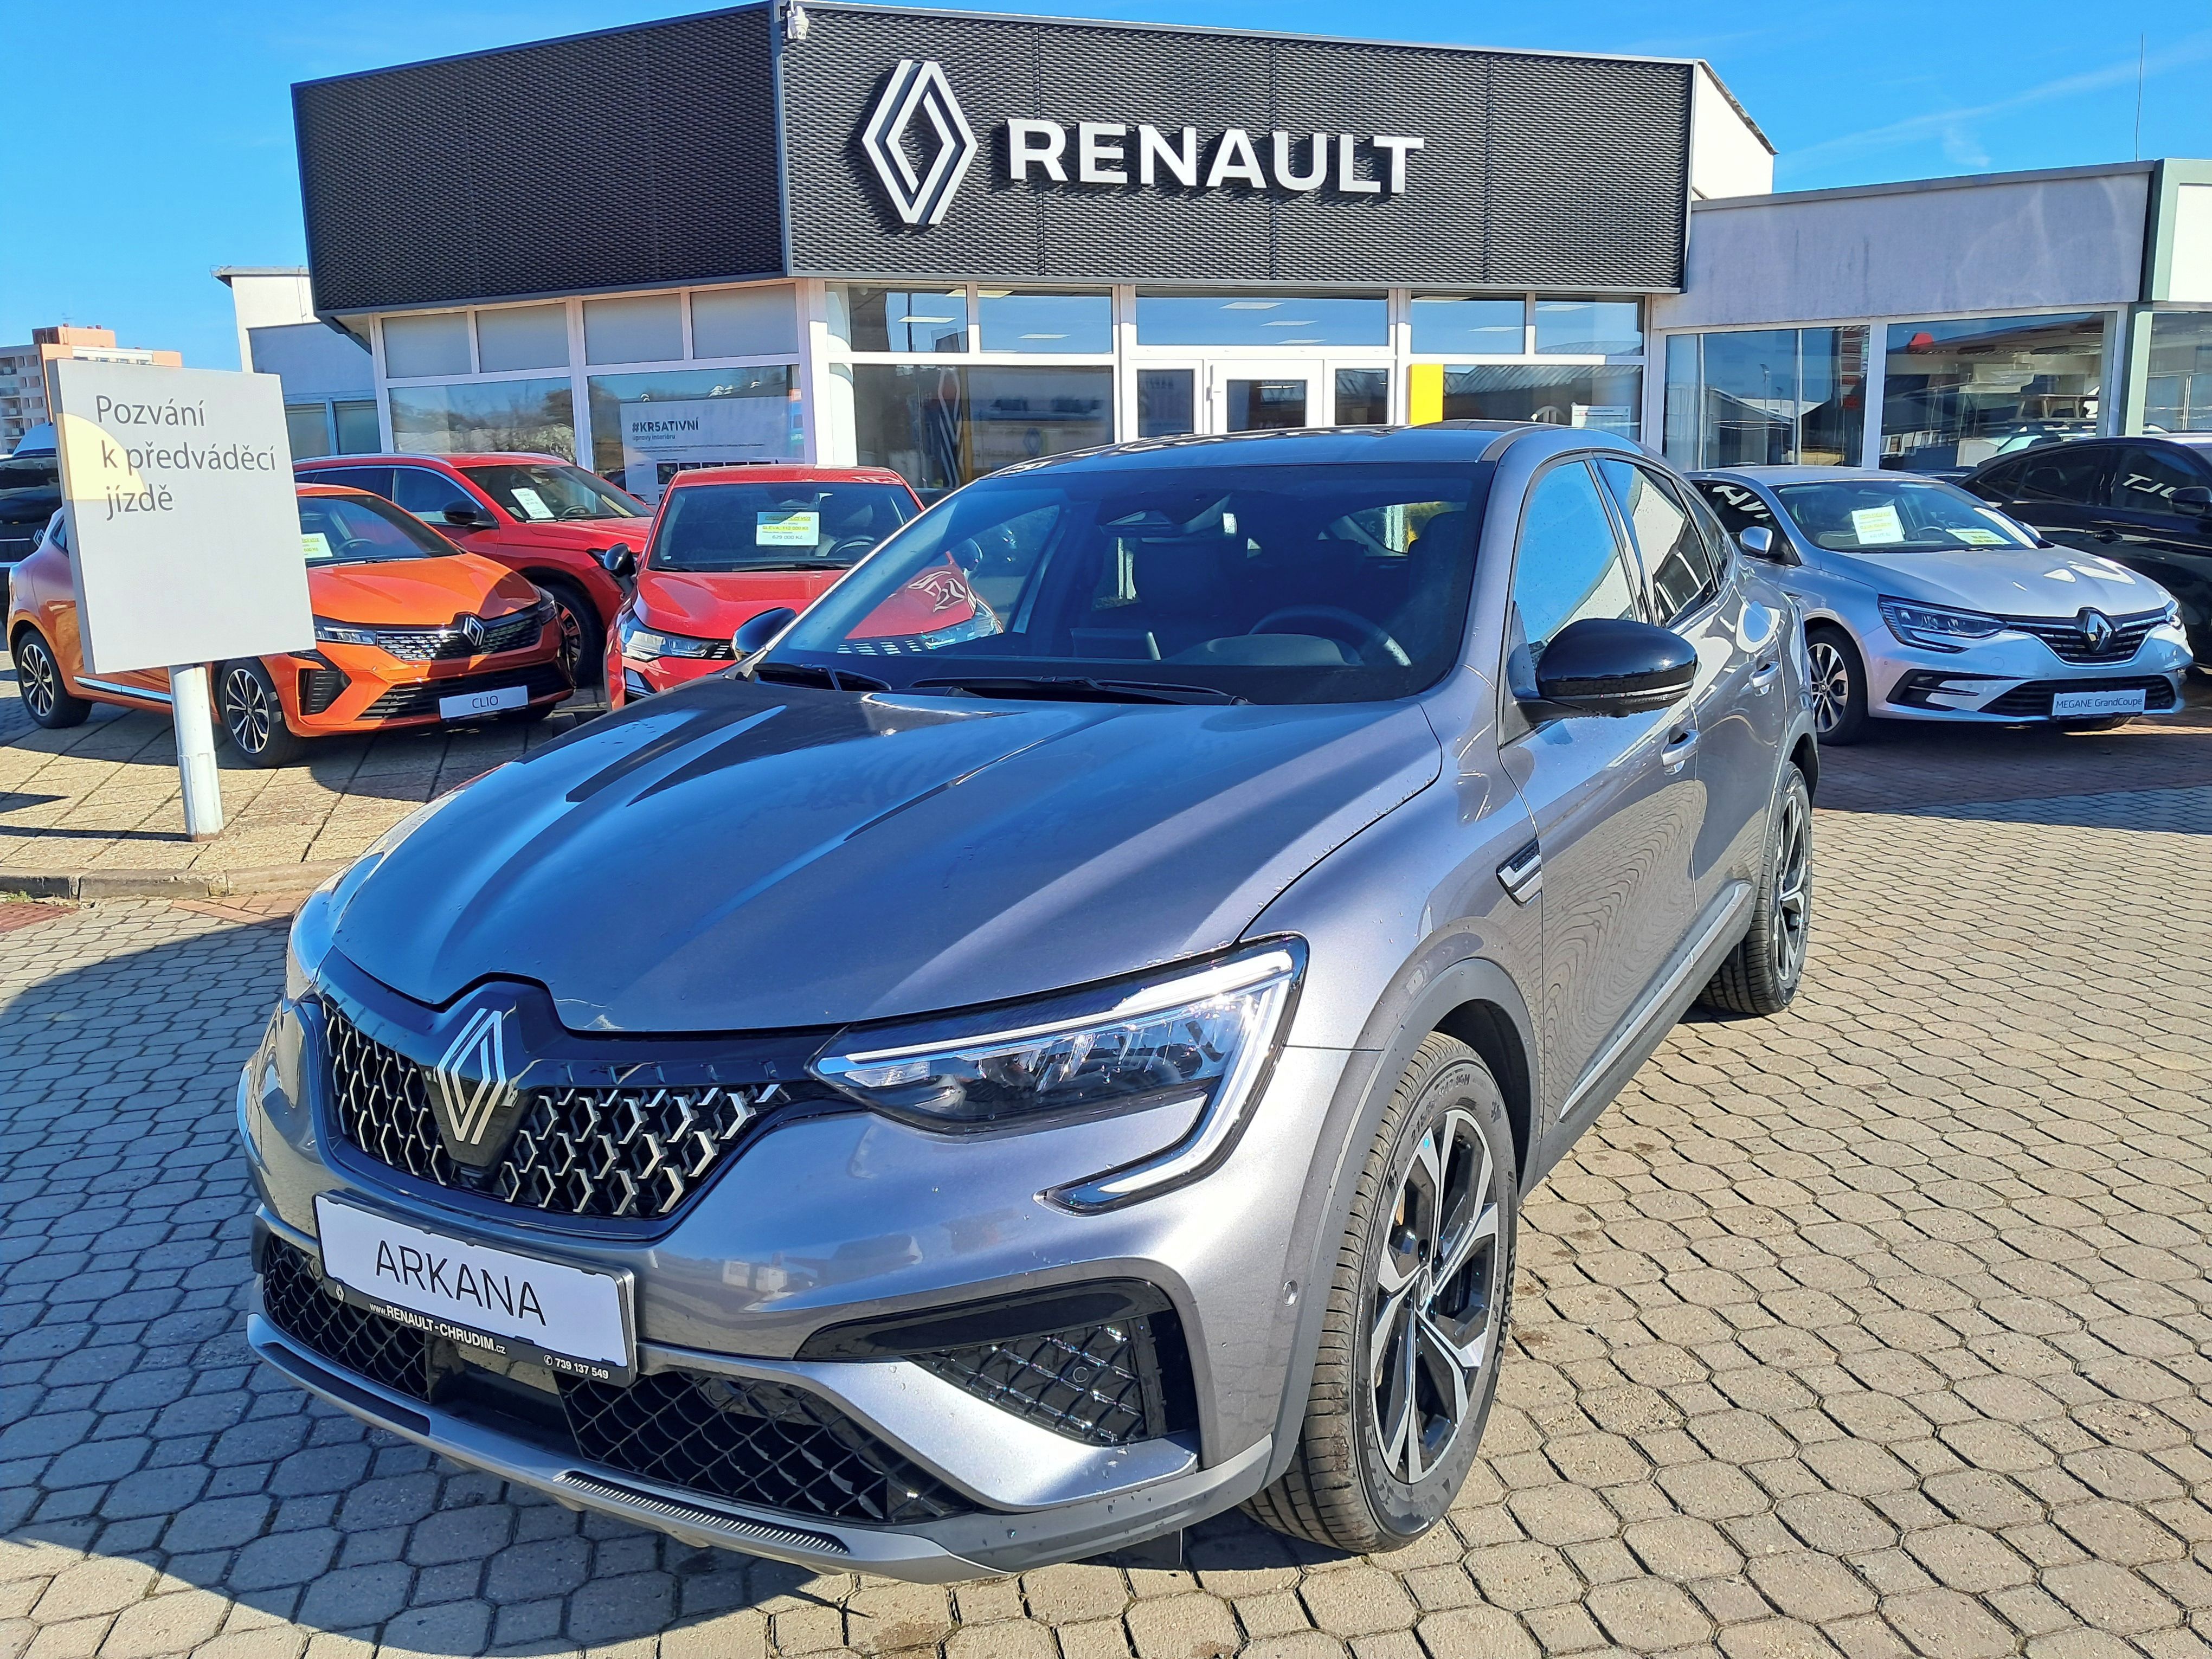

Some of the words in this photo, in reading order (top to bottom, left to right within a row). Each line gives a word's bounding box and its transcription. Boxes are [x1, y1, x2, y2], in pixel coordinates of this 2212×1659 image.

[1006, 118, 1425, 193] RENAULT
[96, 395, 204, 426] Pozvání
[632, 417, 699, 432] #KR5ATIVNÍ
[101, 440, 118, 468] k
[126, 441, 276, 476] předváděcí
[106, 483, 173, 521] jízdě
[472, 695, 499, 709] CLIO
[2056, 699, 2093, 709] MEGANE
[2094, 696, 2143, 707] GrandCoupé
[376, 1240, 546, 1327] ARKANA
[369, 1302, 506, 1354] www.RENAULT-CHRUDIM.cz
[555, 1358, 572, 1371] 739
[574, 1362, 589, 1375] 137
[591, 1367, 609, 1380] 549
